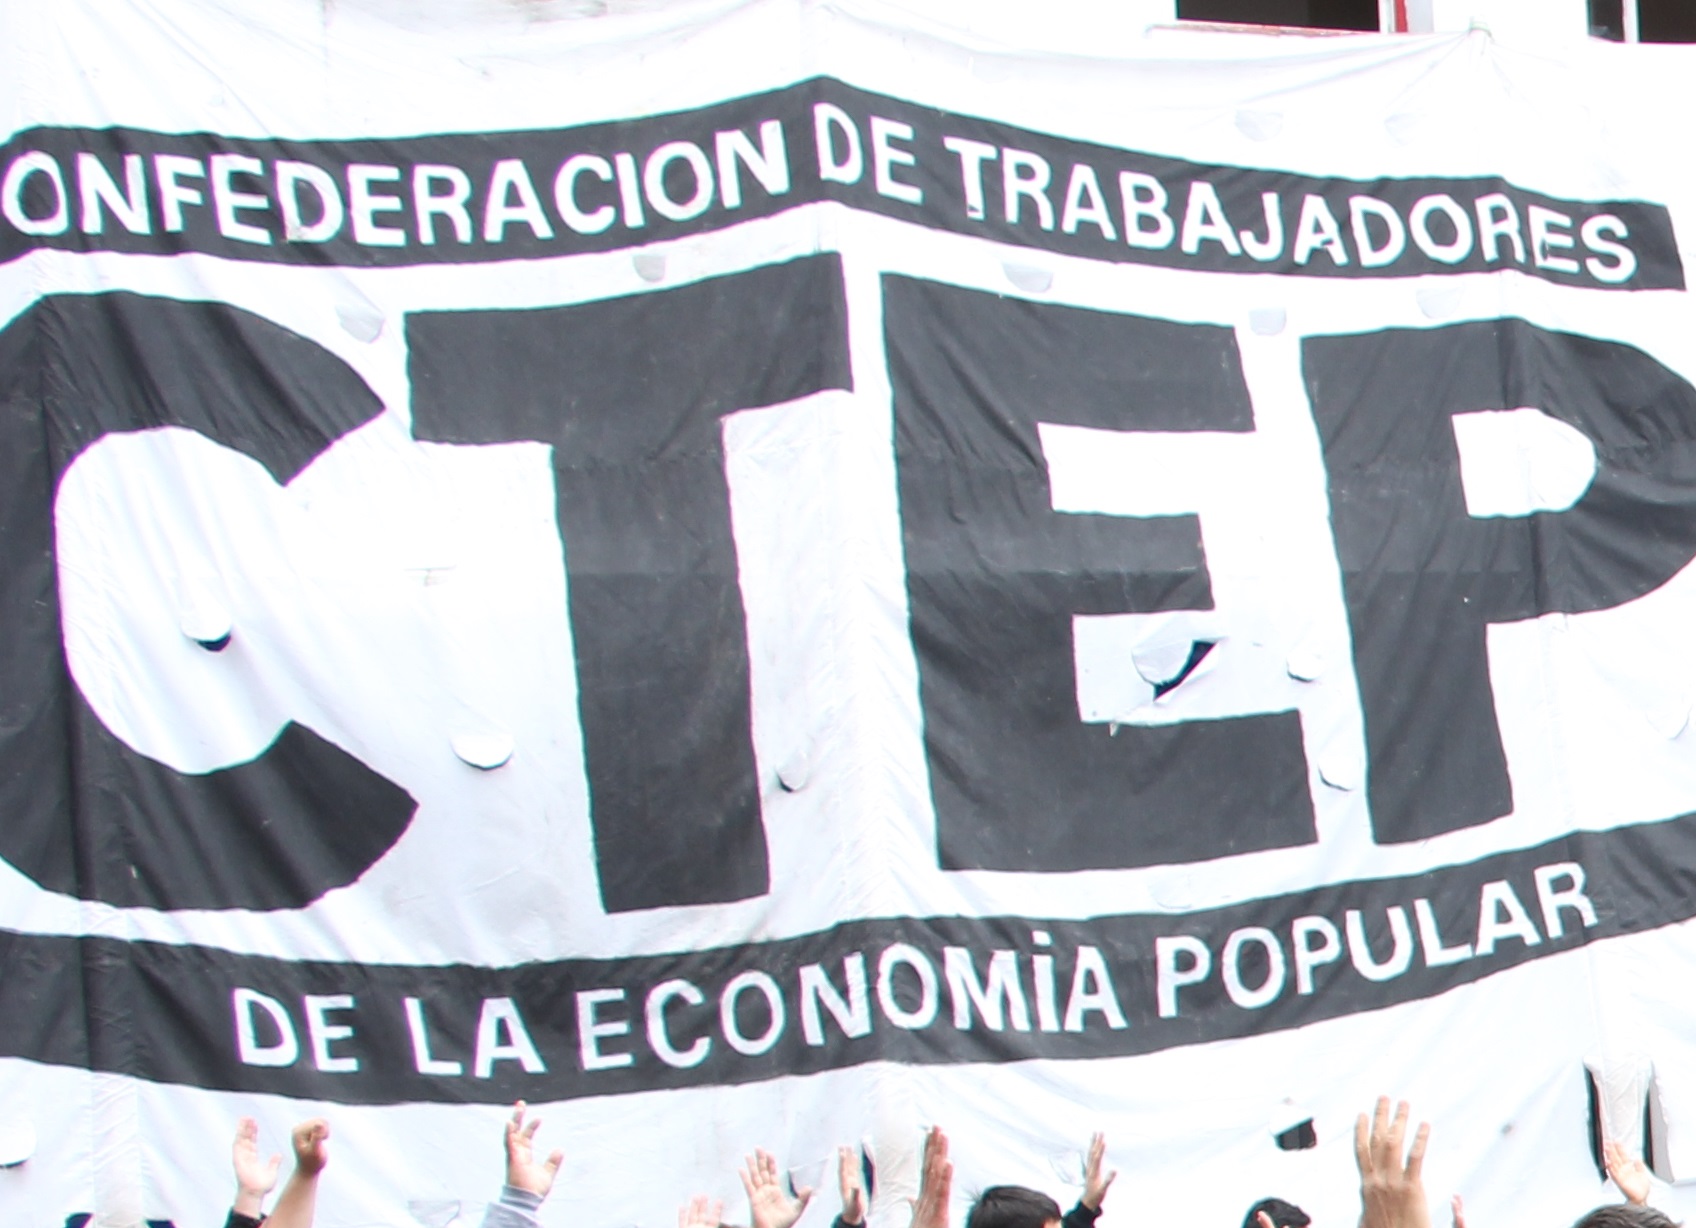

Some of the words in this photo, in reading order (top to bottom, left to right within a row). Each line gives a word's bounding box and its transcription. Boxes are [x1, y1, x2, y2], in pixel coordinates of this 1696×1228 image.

[813, 102, 923, 205] DE
[943, 136, 1638, 284] TRABAJADORES
[234, 987, 360, 1073] DE
[404, 996, 546, 1079] LA
[1154, 861, 1599, 1019] POPULAR
